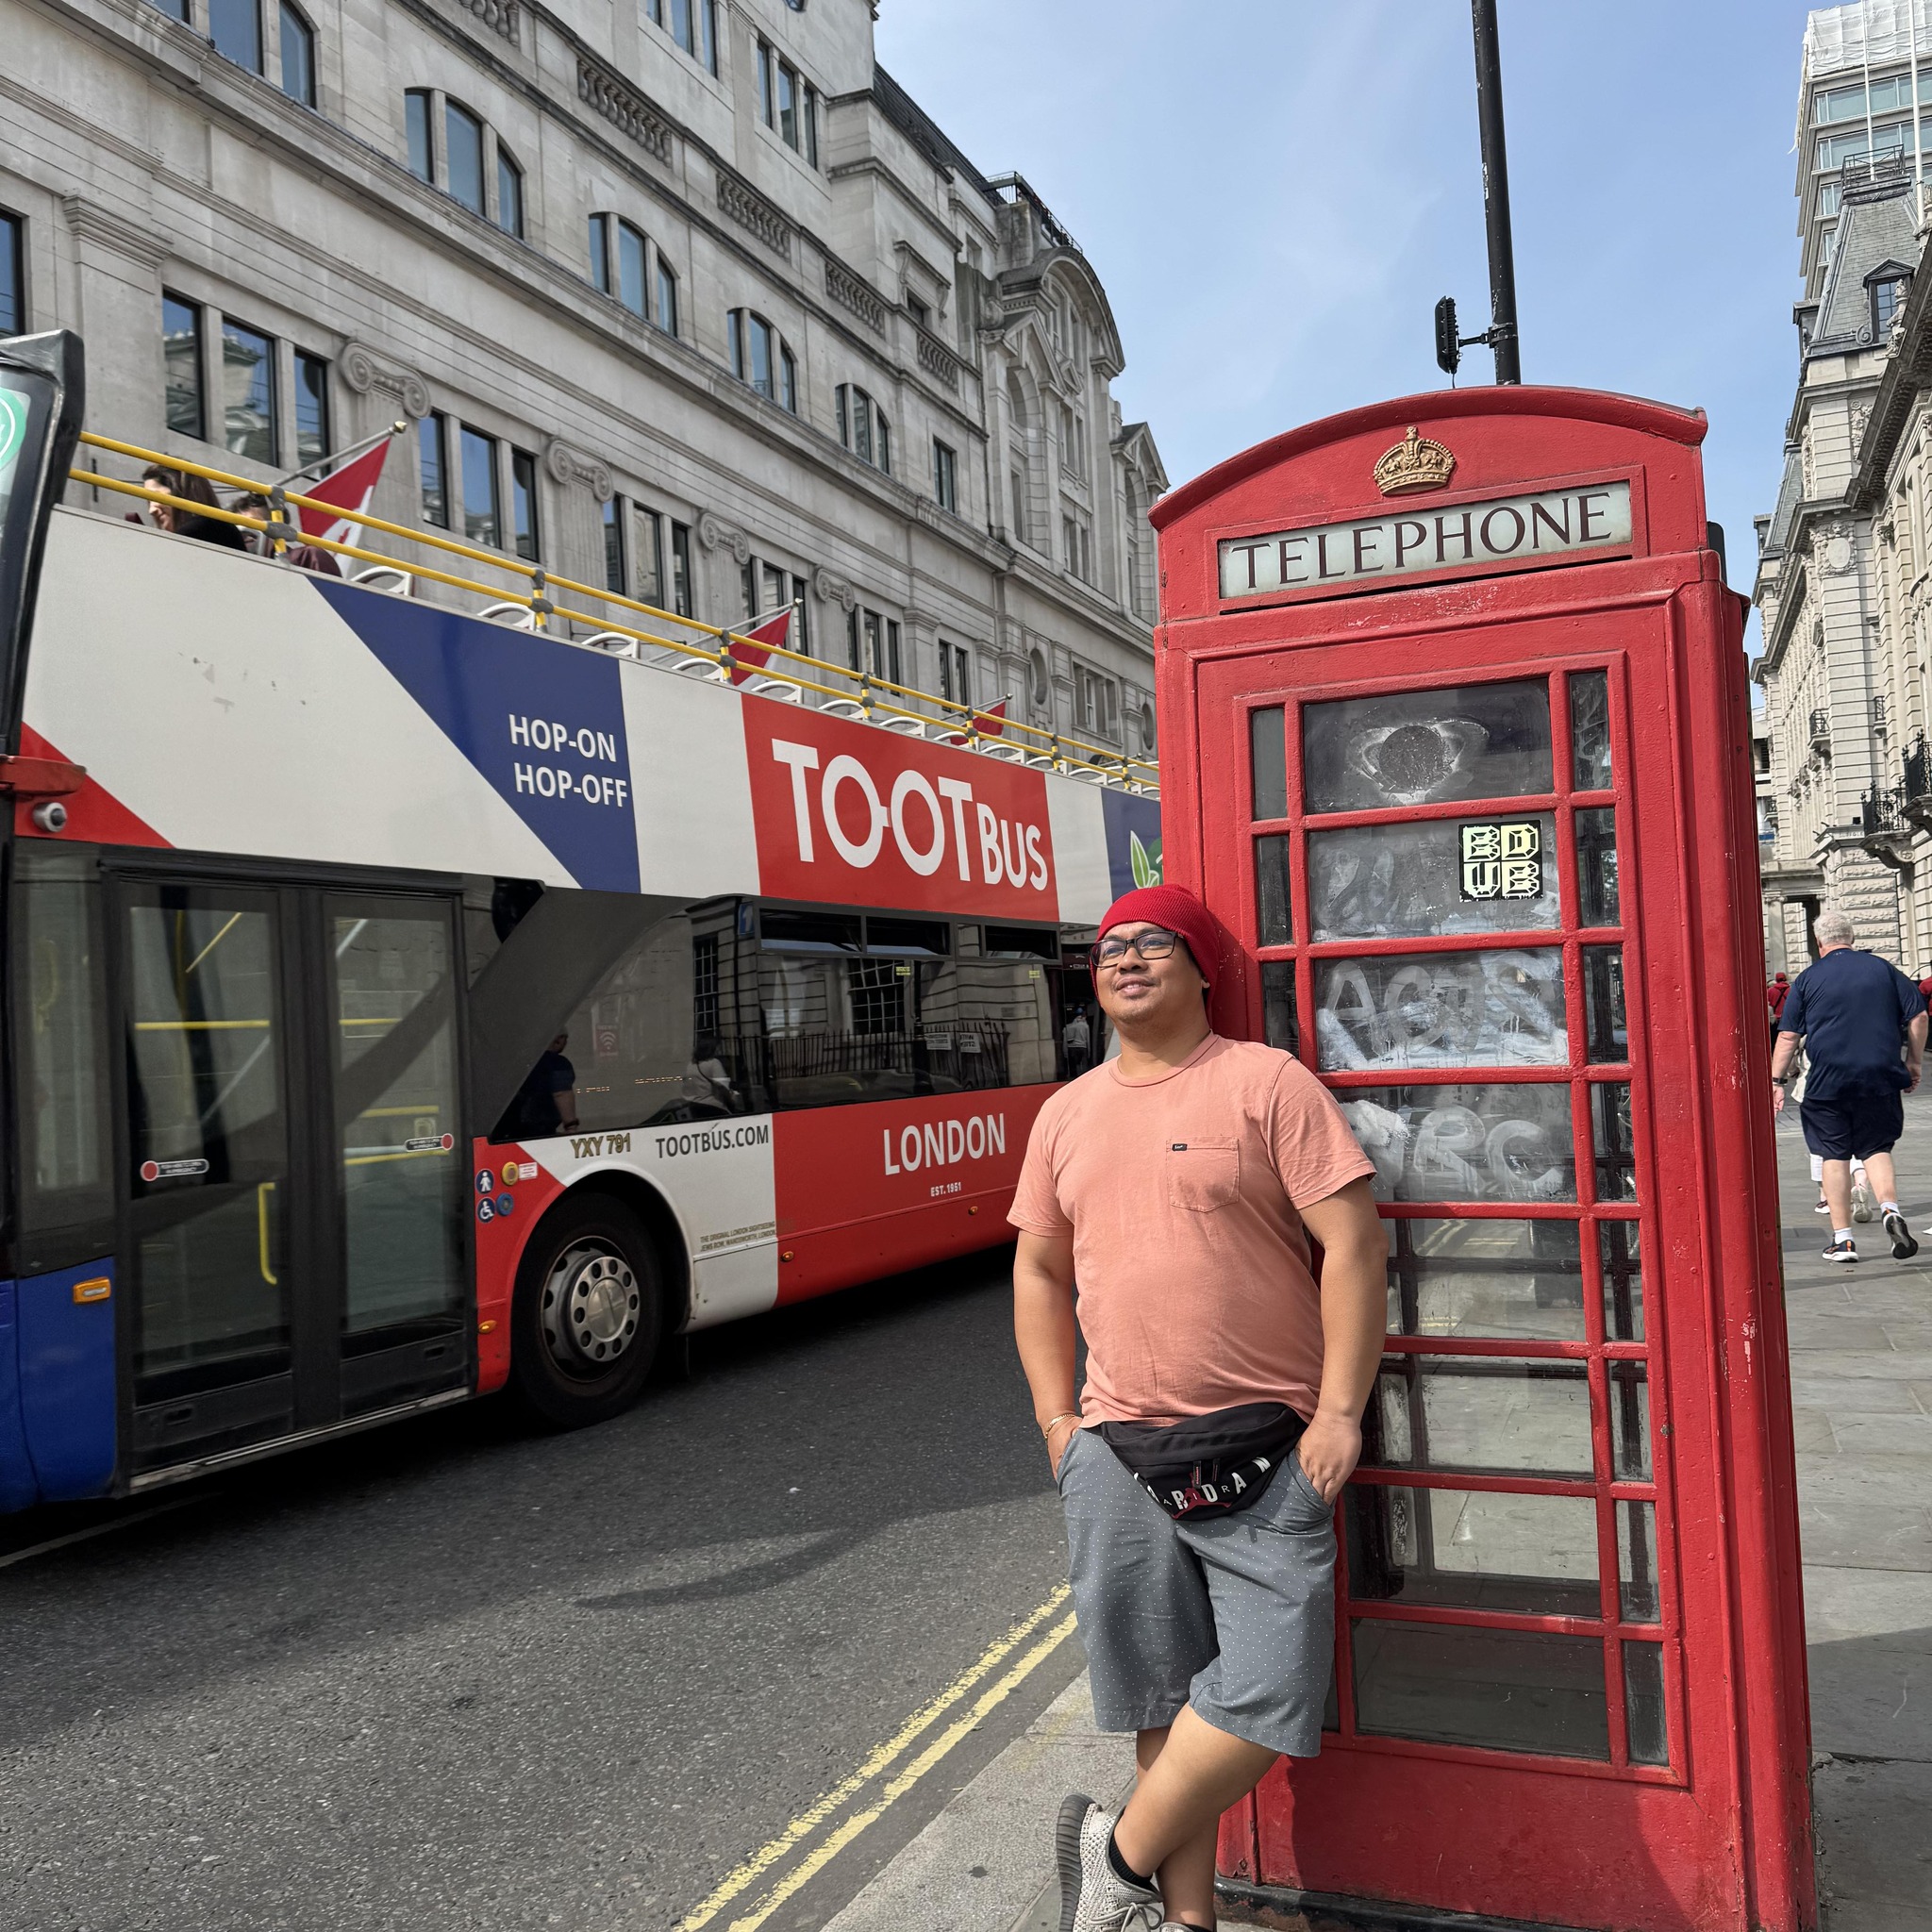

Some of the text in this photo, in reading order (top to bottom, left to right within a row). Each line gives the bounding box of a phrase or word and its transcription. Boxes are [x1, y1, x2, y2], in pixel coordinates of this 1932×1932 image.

[1231, 491, 1611, 589] TELEPHONE
[508, 713, 617, 762] HOP-ON
[514, 762, 627, 808] HOP-OFF
[570, 1132, 631, 1158] YXY 791
[655, 1124, 769, 1158] TOOTBUS.COM
[883, 1112, 1006, 1175] LONDON
[930, 1182, 962, 1197] EST. 1951
